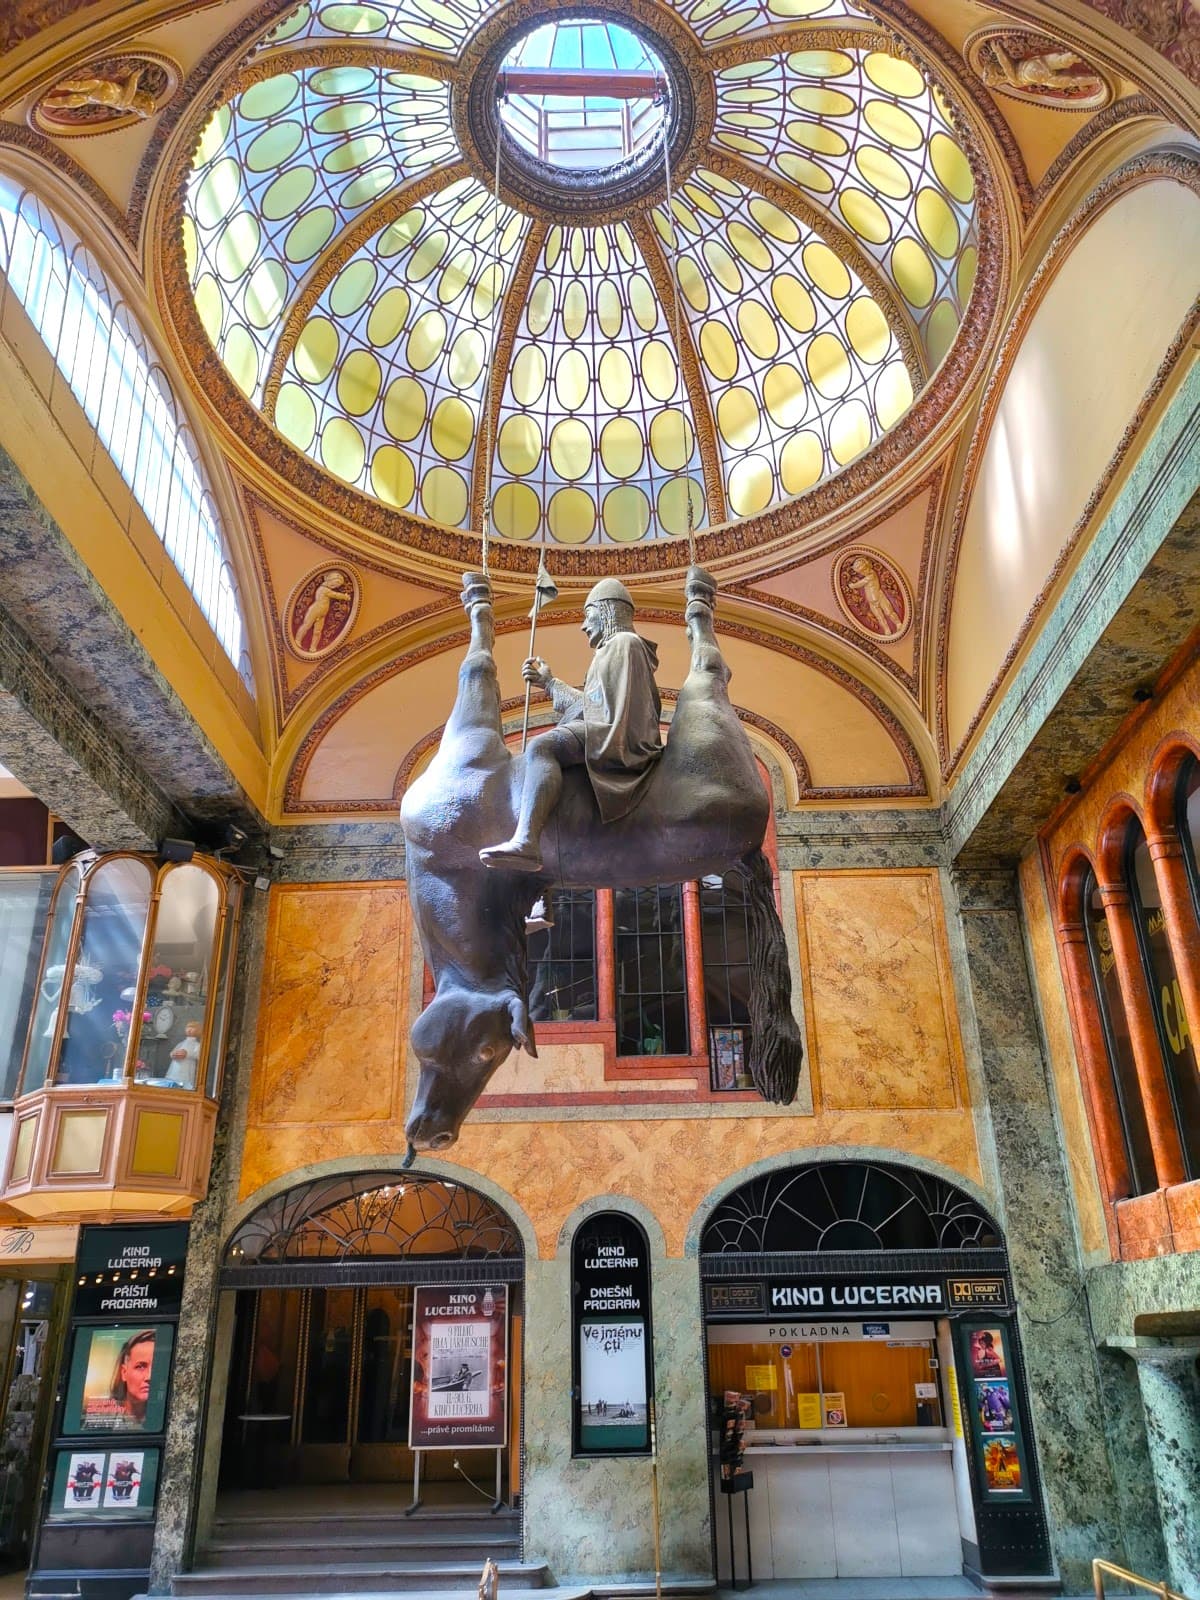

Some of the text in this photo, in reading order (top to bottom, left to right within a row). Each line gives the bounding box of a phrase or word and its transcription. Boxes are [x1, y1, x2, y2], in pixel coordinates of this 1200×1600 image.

[122, 1246, 150, 1257] KINO
[597, 1246, 625, 1257] KINO
[107, 1257, 162, 1269] LUCERNA
[584, 1258, 639, 1269] LUCERNA
[113, 1284, 149, 1297] PŘÍŠTÍ
[590, 1284, 633, 1298] DNEŠNÍ
[974, 1285, 997, 1293] DOLBY
[449, 1294, 477, 1304] KINO
[772, 1285, 942, 1306] KINO LUCERNA
[100, 1298, 158, 1310] PROGRAM
[583, 1299, 641, 1310] PROGRAM
[424, 1305, 477, 1316] LUCERNA
[582, 1326, 599, 1339] Ve
[768, 1326, 851, 1337] POKLADNA
